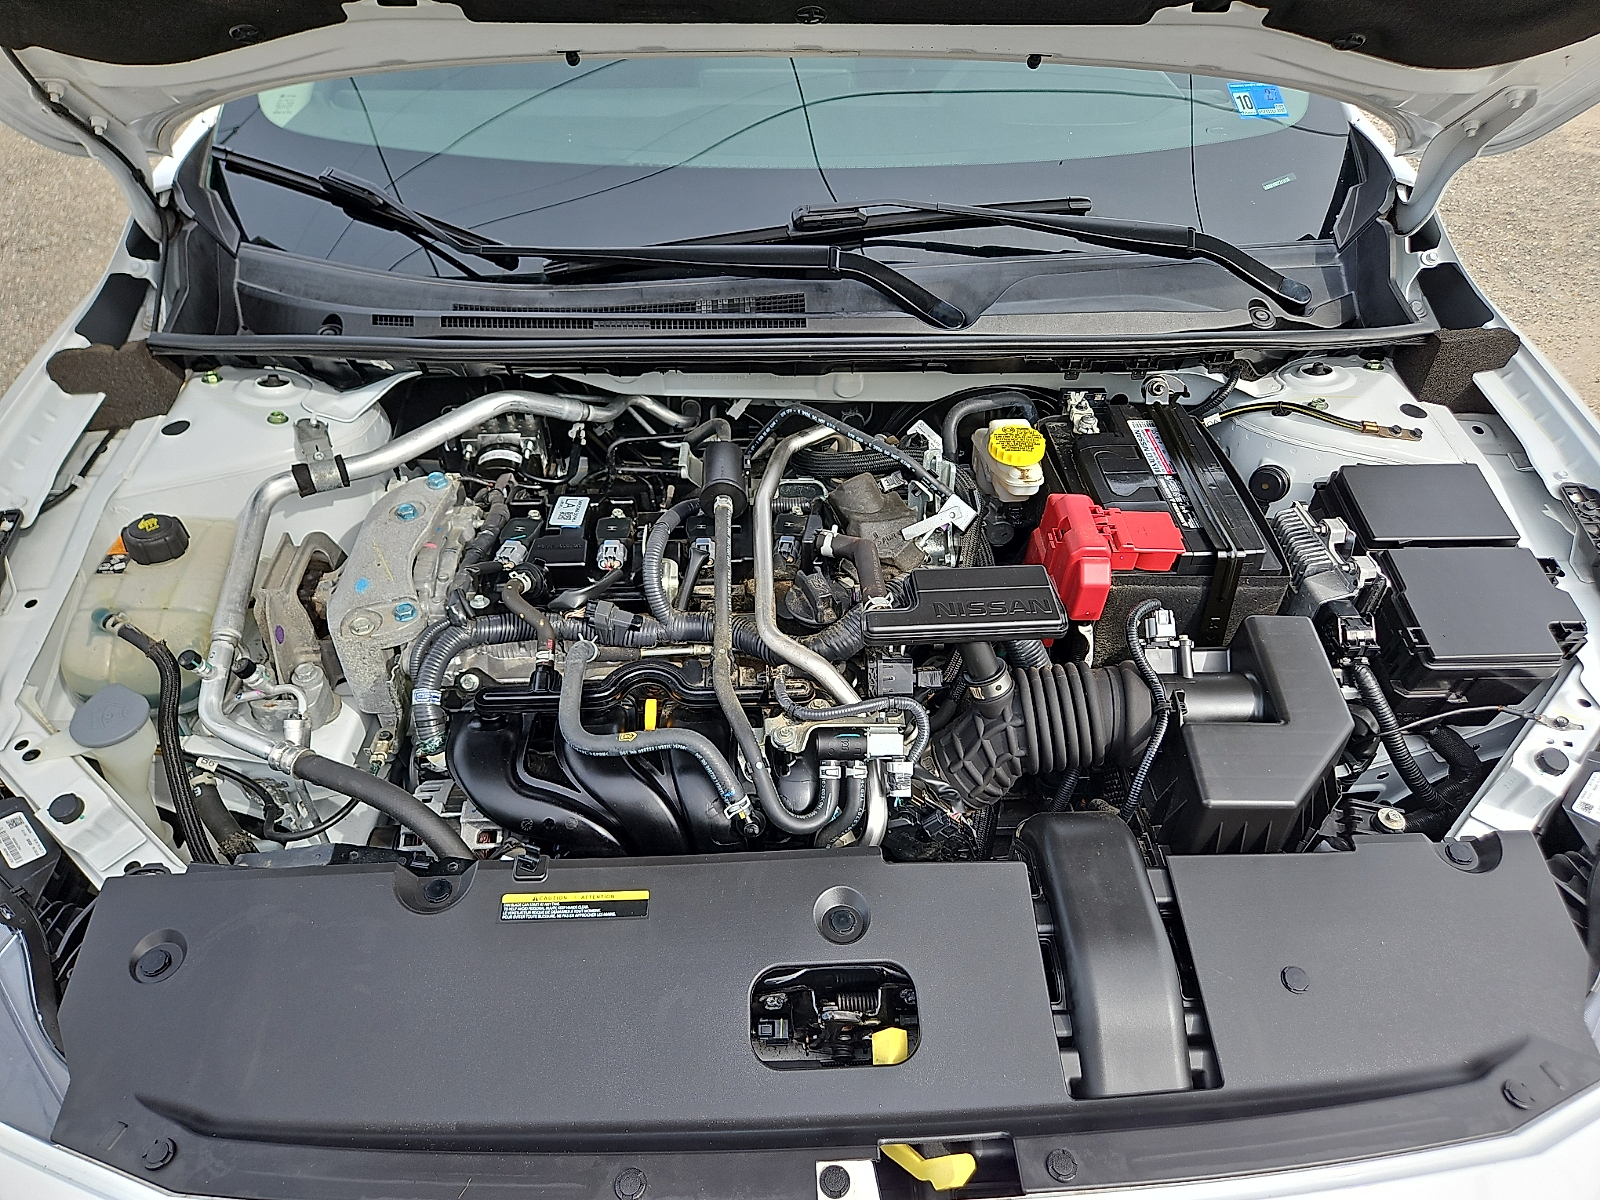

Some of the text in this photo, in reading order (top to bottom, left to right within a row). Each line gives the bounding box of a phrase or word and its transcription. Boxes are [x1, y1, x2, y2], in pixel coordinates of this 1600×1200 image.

[1236, 94, 1254, 110] 10
[563, 499, 578, 509] LA
[933, 599, 1053, 618] NISSAN
